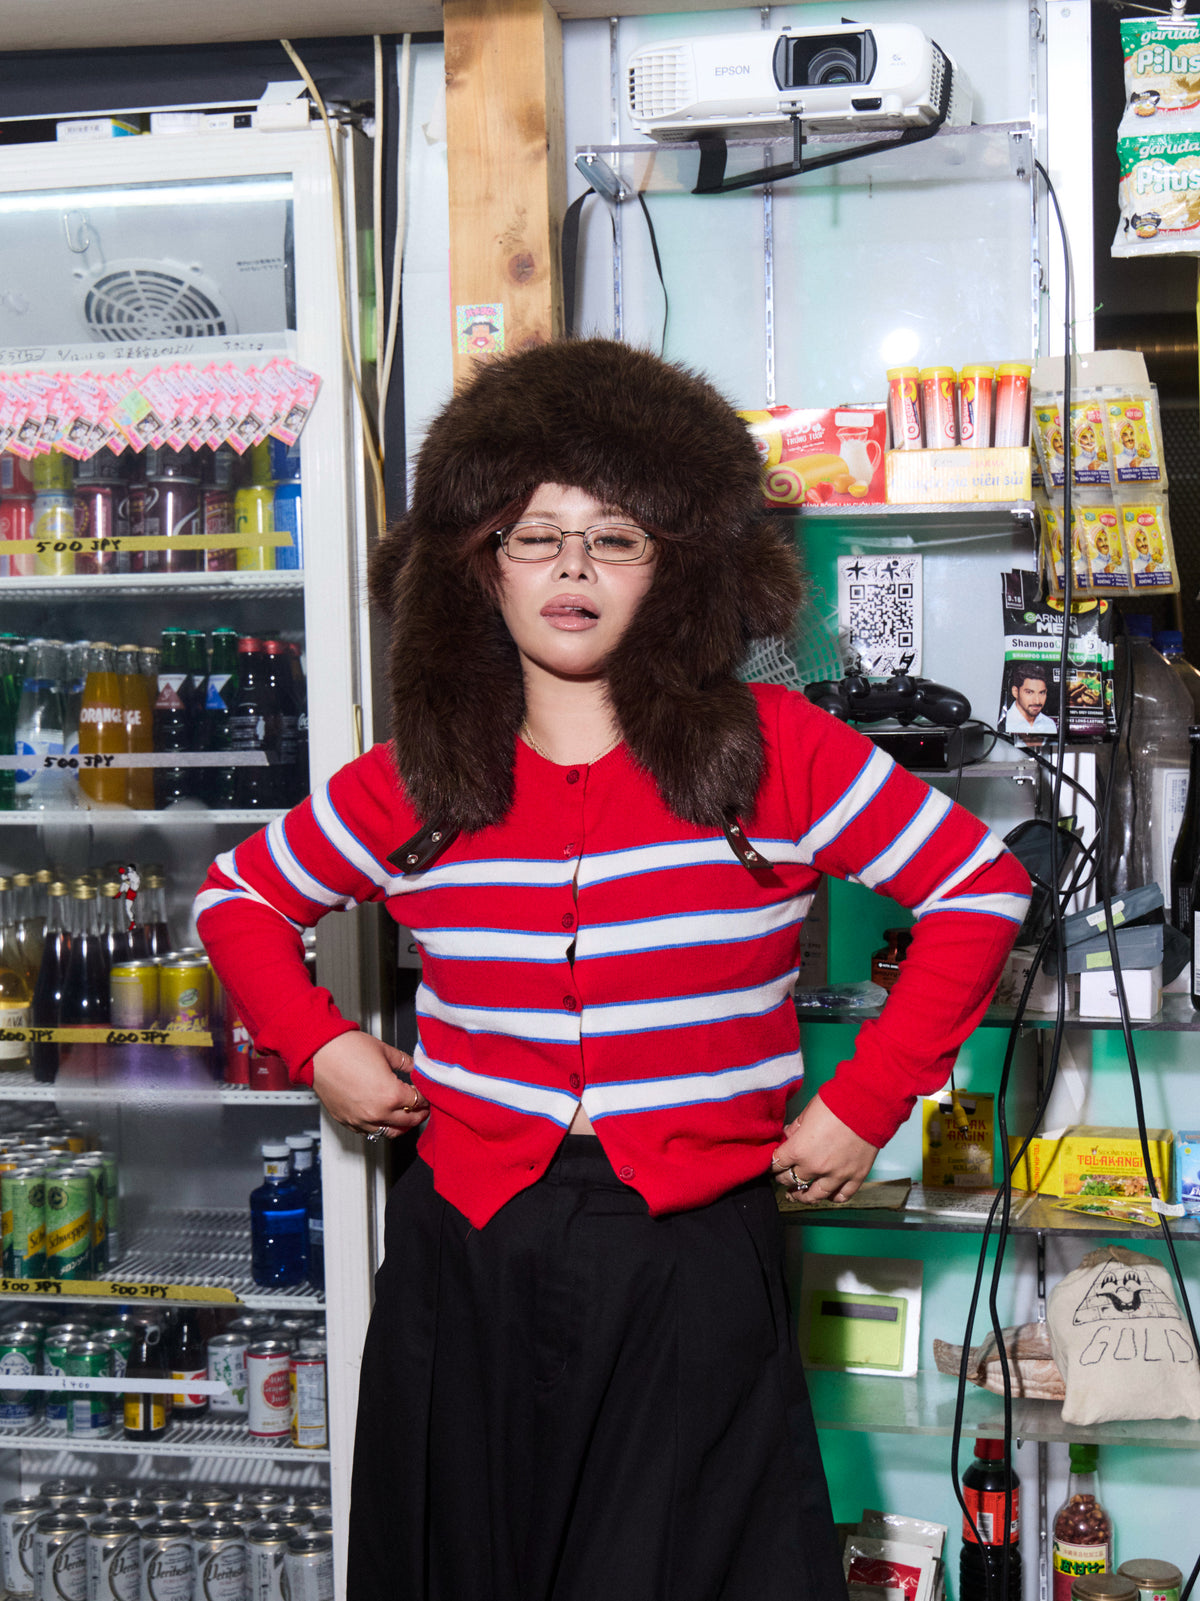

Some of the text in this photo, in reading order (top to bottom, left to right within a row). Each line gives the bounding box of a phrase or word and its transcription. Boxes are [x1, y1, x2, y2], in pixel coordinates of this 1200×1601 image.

[715, 65, 750, 76] EPSON
[36, 539, 122, 553] 500 JPY
[80, 708, 122, 723] ORANGE
[44, 755, 115, 768] 500 JPY
[29, 1030, 54, 1041] JPY
[106, 1031, 170, 1044] 600 JPY
[2, 1280, 62, 1294] 500 JPY
[110, 1284, 169, 1298] 500 JPY
[1079, 1325, 1194, 1366] GOLD
